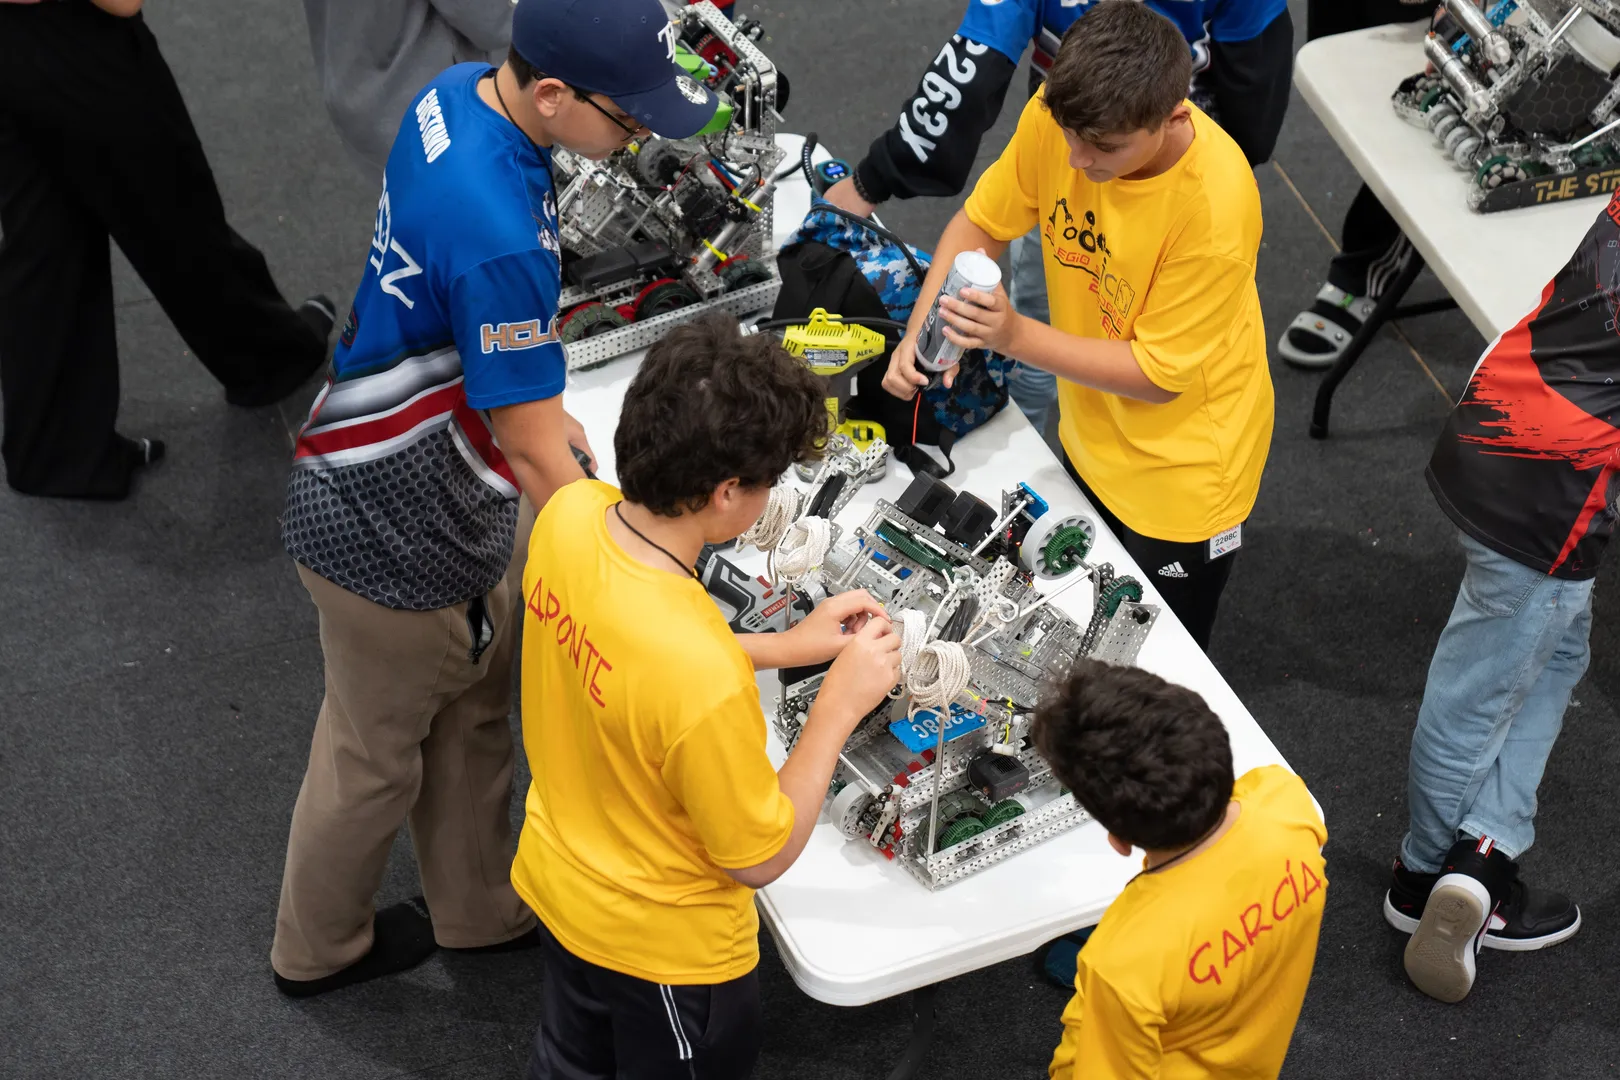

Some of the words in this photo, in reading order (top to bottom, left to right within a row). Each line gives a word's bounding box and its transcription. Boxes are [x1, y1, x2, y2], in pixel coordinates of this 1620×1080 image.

[415, 88, 451, 163] GUSTAVO
[1536, 177, 1579, 202] THE
[856, 348, 874, 358] ALEK
[1158, 569, 1188, 578] adidas
[527, 577, 613, 709] APONTE
[1188, 860, 1322, 986] GARCÍA
